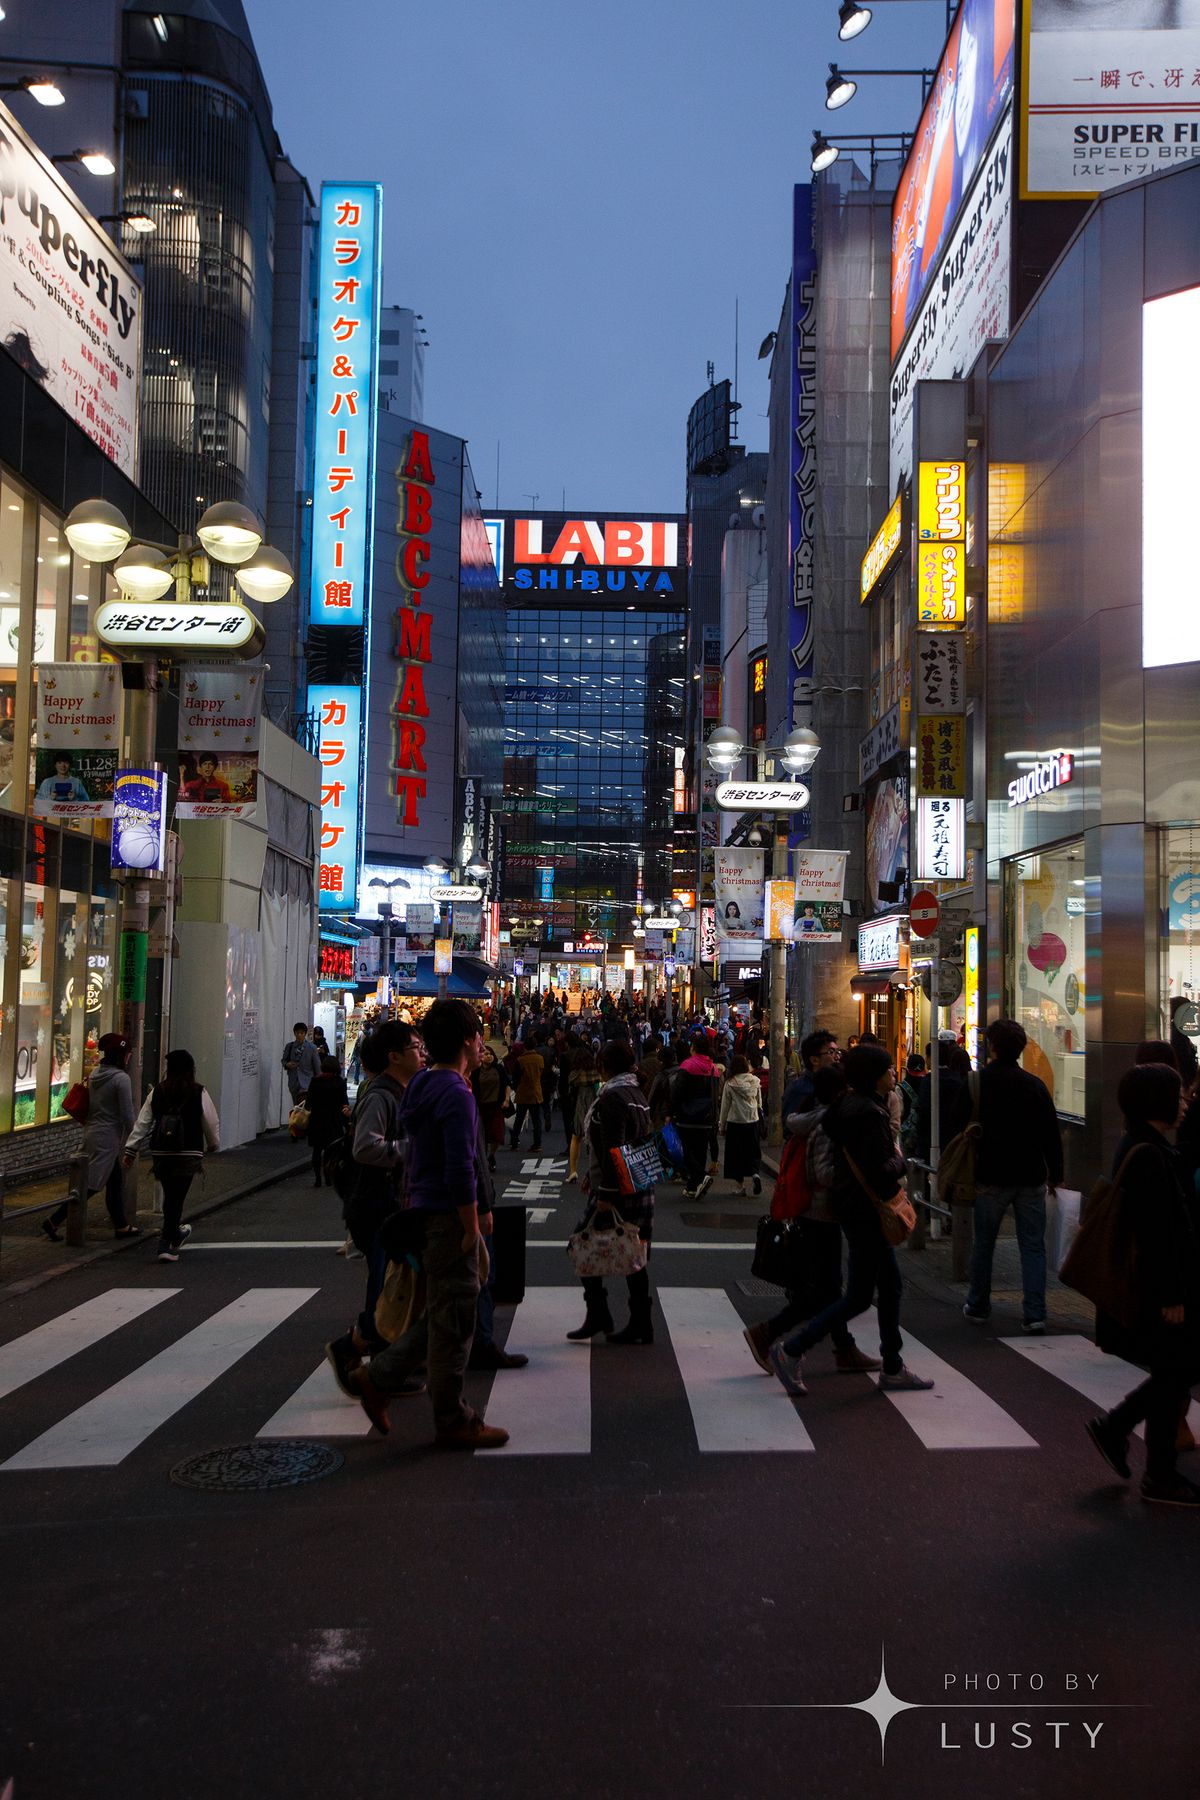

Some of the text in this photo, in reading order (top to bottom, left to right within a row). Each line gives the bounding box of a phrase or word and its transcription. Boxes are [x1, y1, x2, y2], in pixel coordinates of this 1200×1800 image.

[1074, 124, 1163, 144] SUPER
[1073, 147, 1149, 159] SPEED
[941, 133, 1011, 310] Superfly
[28, 259, 73, 319] Coupling
[75, 310, 101, 346] Songs
[891, 293, 939, 415] Superfly
[324, 200, 361, 608] カラオケ&パーティー館
[935, 465, 961, 540] プリクラ
[514, 520, 678, 567] LABI
[920, 529, 937, 539] 3F
[514, 569, 674, 592] SHIBUYA
[924, 552, 937, 608] パウダールーム
[942, 546, 957, 620] のメッカ
[103, 614, 246, 634] 渋谷センター街
[921, 610, 938, 620] 2F
[920, 640, 946, 706] ふたご
[43, 694, 84, 709] Happy
[184, 697, 225, 712] Happy
[47, 711, 116, 726] Christmas!
[188, 714, 256, 728] Christmas!
[78, 758, 113, 771] 11.28
[1008, 755, 1060, 808] swatch
[321, 699, 347, 892] カラオケ館
[722, 789, 804, 801] 渋谷センター街
[719, 866, 743, 876] Happy
[799, 868, 824, 879] Happy
[721, 877, 763, 886] Christmas!
[801, 879, 842, 888] Christmas!
